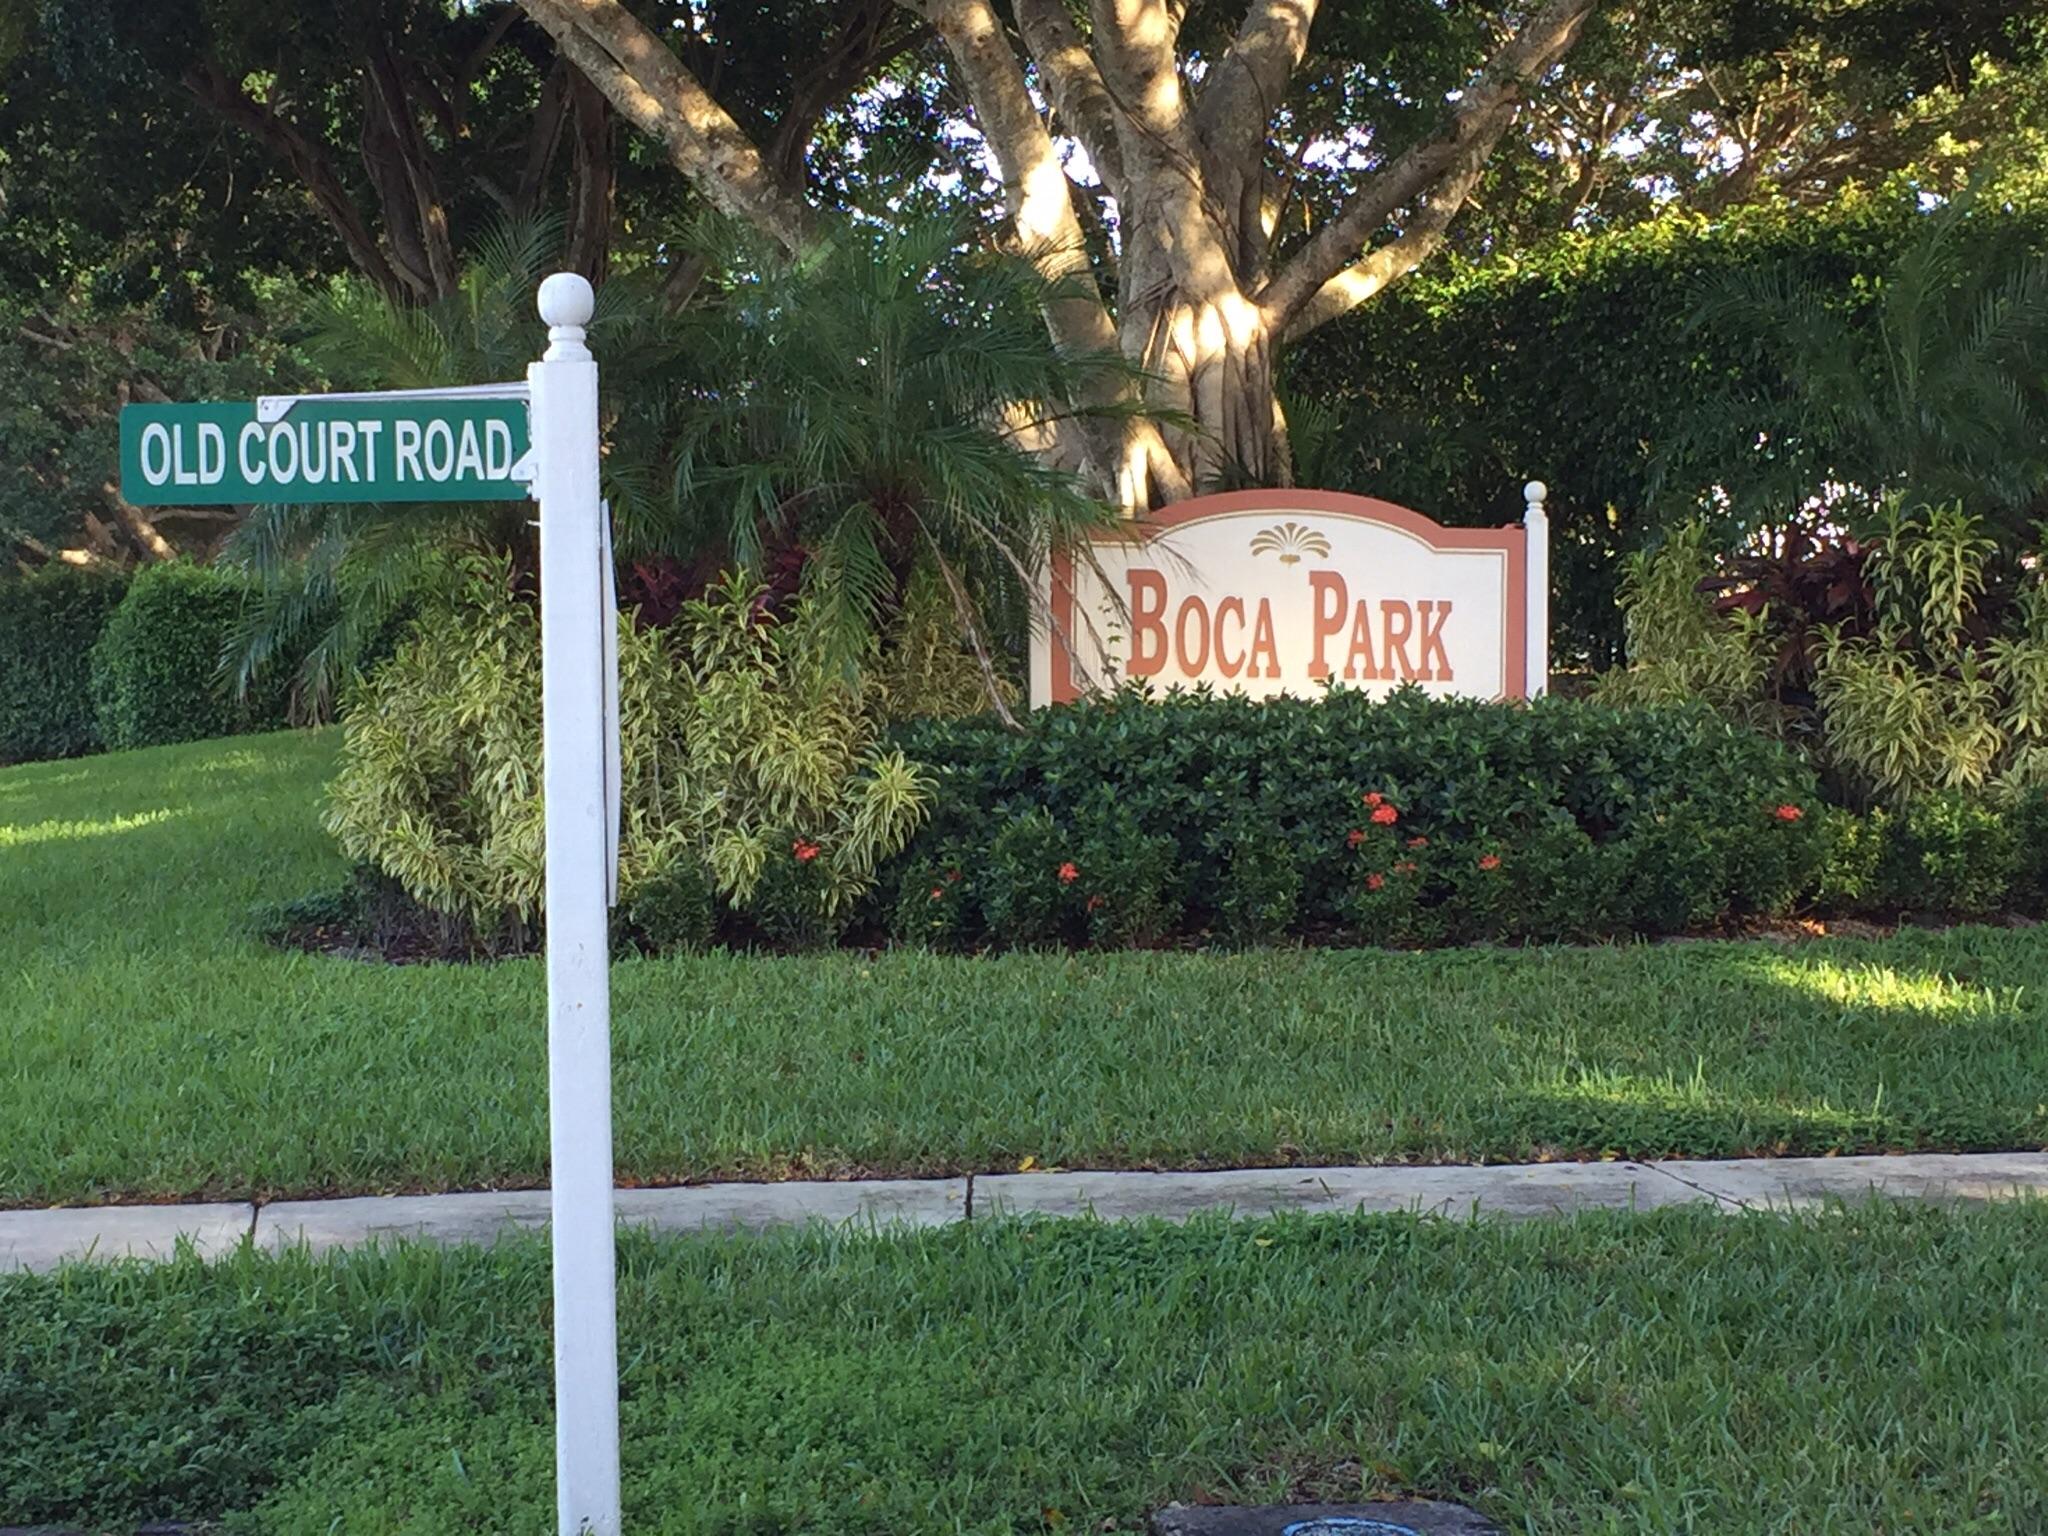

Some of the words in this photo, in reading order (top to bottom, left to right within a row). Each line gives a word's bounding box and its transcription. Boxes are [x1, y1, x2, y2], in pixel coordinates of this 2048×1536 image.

[140, 421, 226, 486] OLD
[238, 420, 382, 485] COURT
[395, 418, 513, 483] ROAD
[1126, 568, 1281, 679] BOCA
[1307, 569, 1454, 681] PARK
